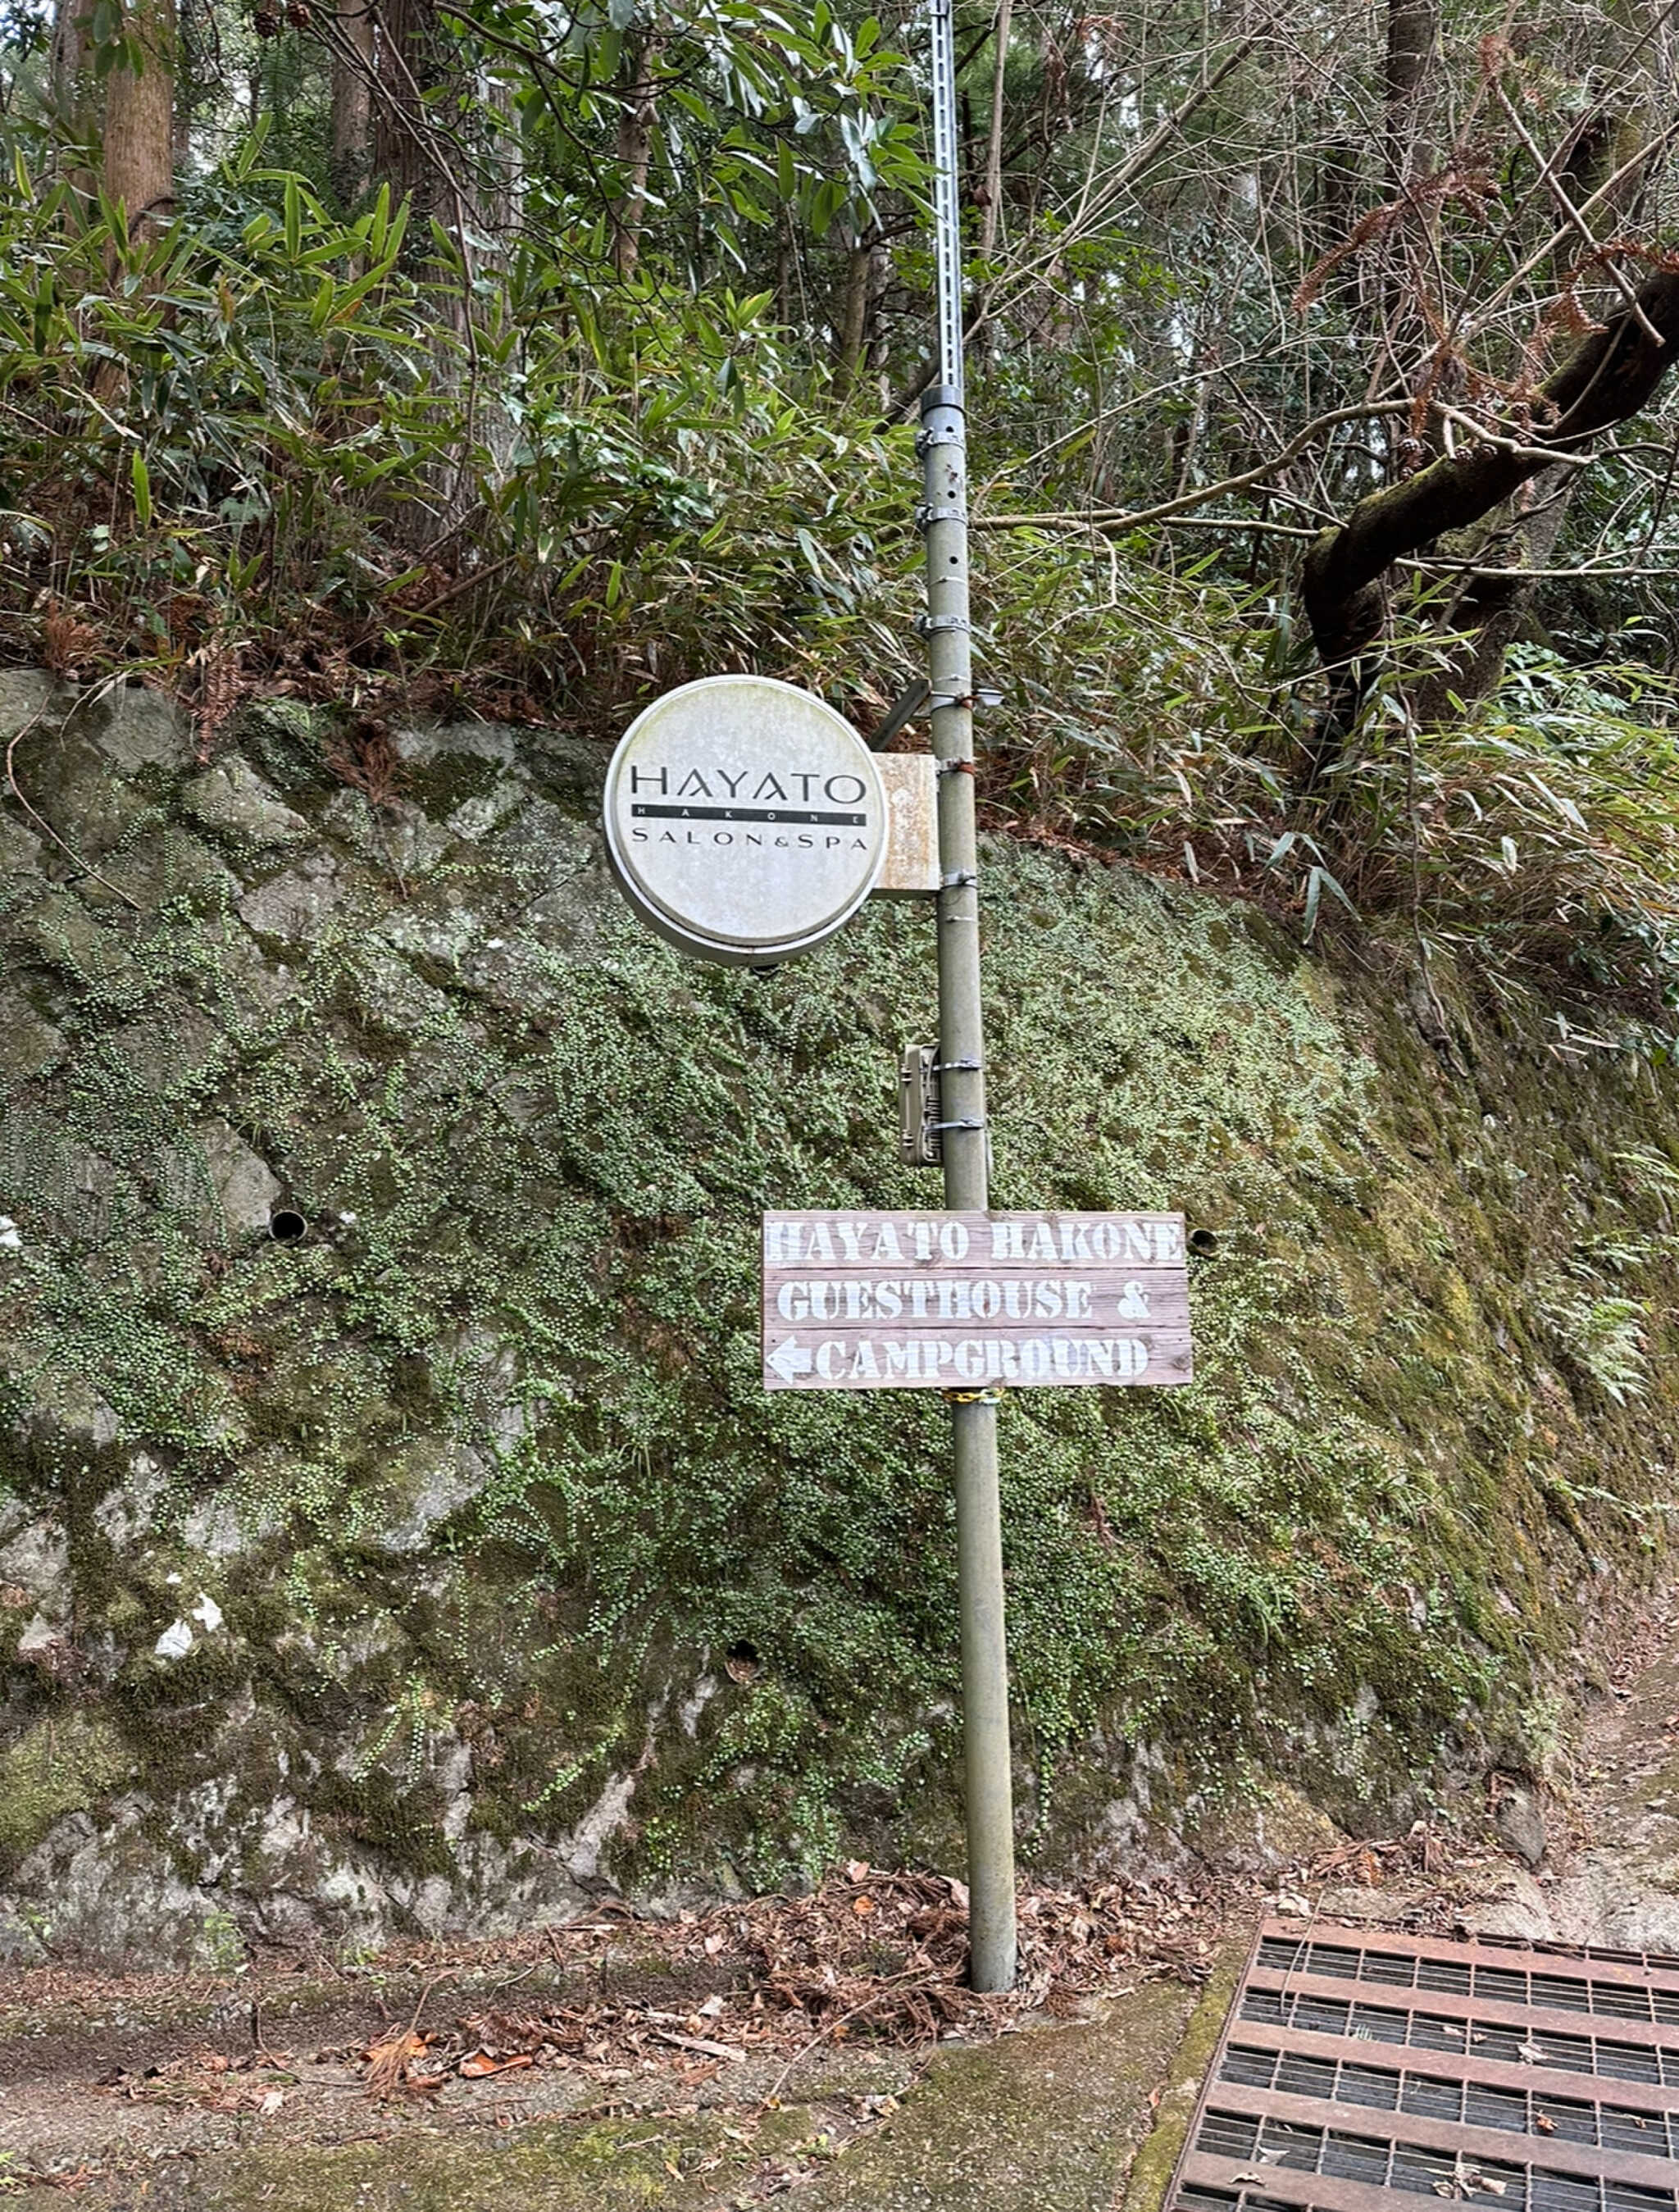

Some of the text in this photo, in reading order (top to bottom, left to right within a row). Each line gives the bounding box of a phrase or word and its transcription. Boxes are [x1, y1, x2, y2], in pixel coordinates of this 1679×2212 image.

[631, 765, 867, 804] HAYATO
[637, 807, 859, 825] HAKONE
[766, 1222, 1183, 1261] HAYATO HAKONE
[777, 1280, 1151, 1322] GUESTHOUSE &
[816, 1338, 1149, 1381] CAMPGROUND
